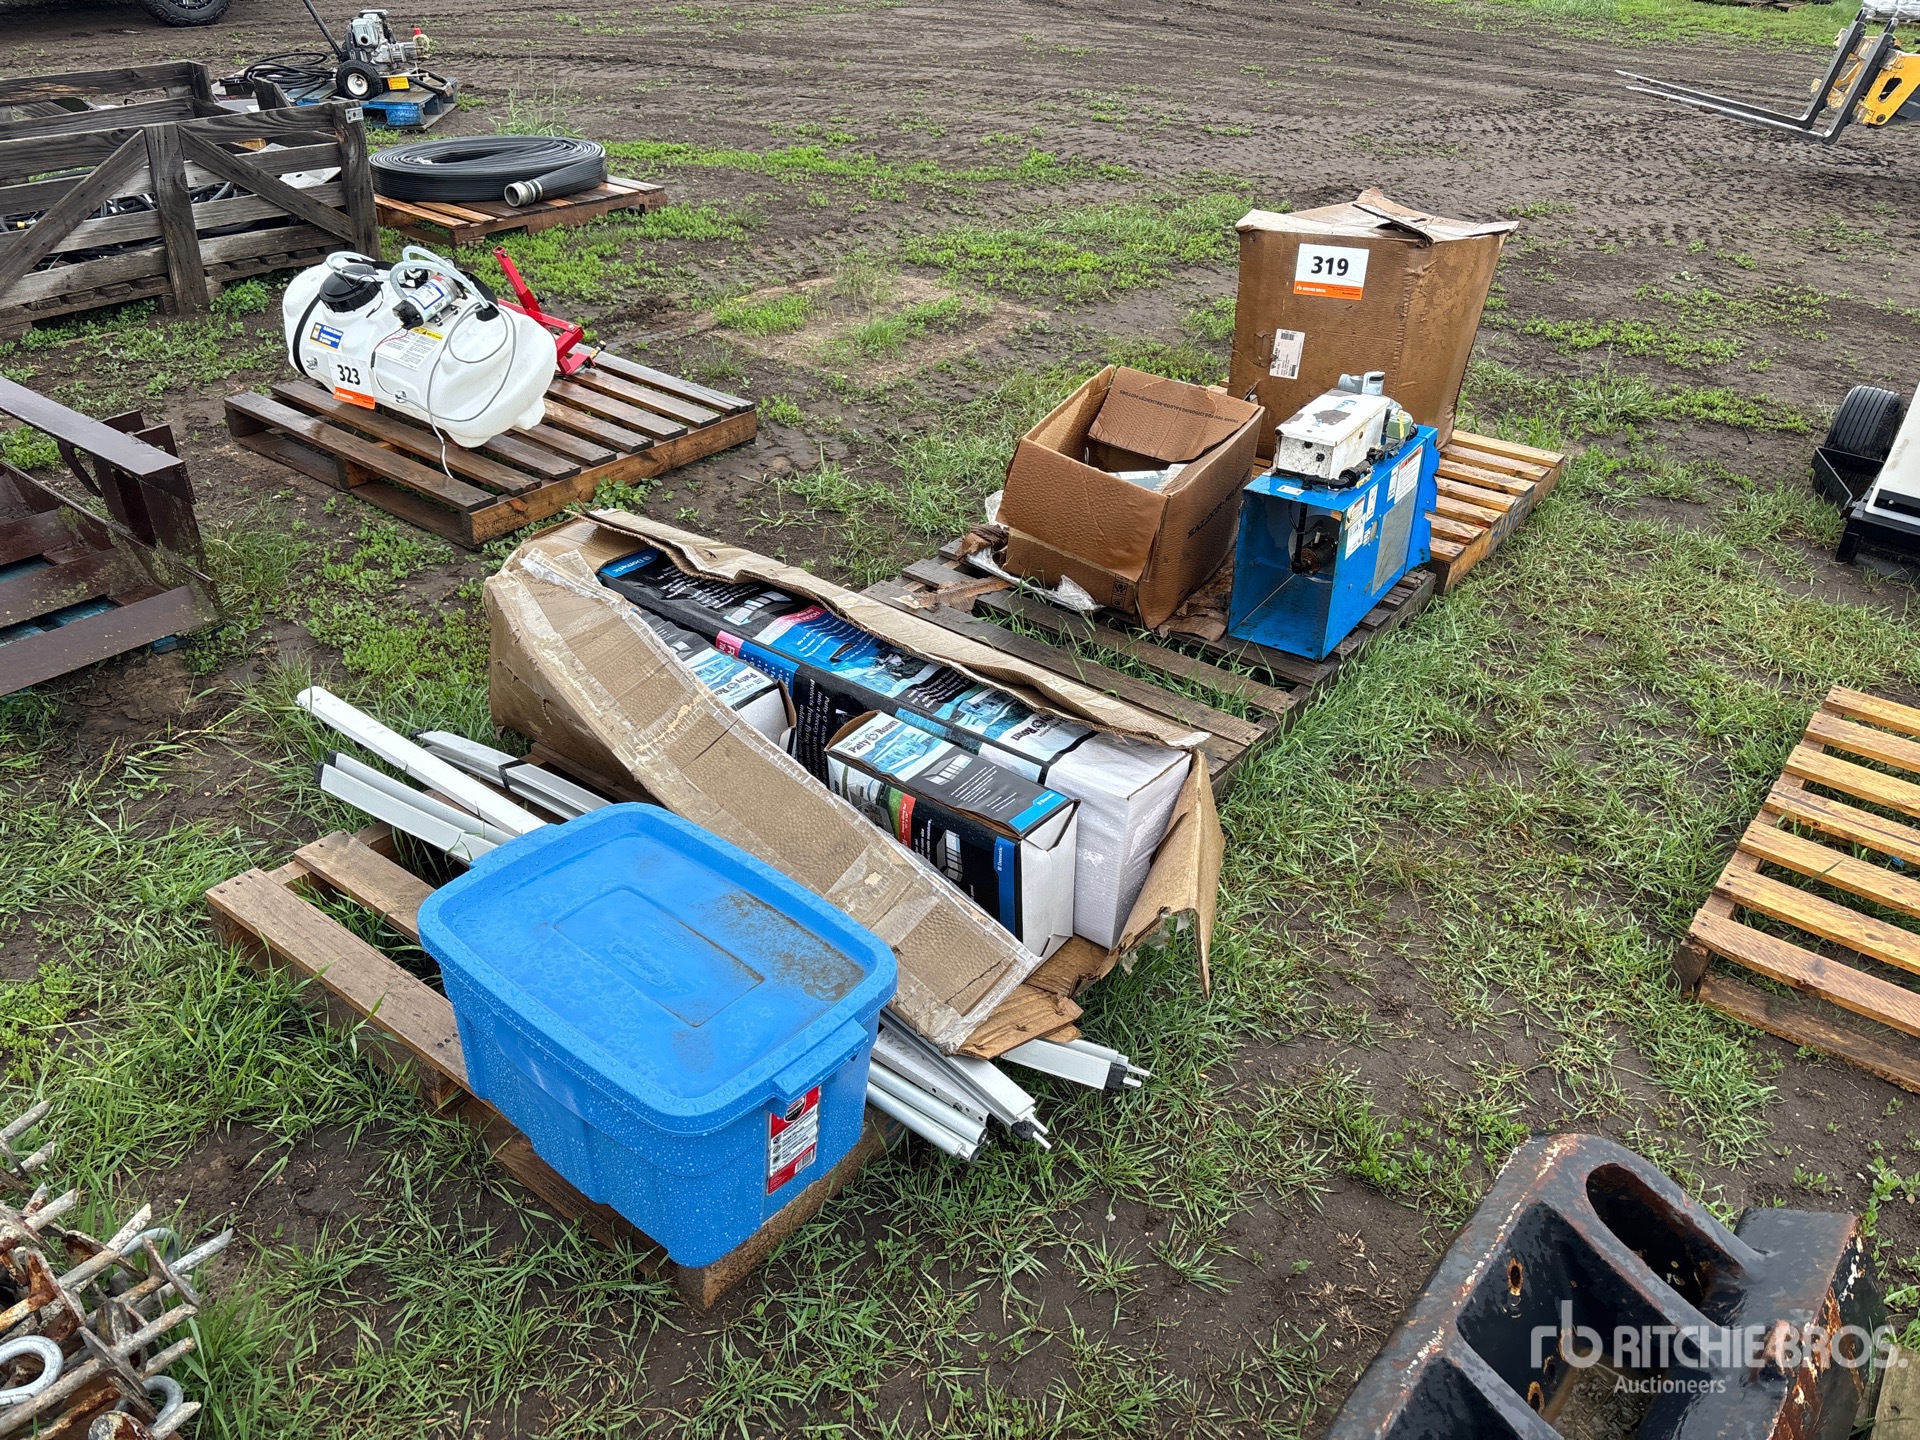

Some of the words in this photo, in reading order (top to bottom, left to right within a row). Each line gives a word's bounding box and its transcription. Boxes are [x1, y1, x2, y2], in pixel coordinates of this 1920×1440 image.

[1311, 256, 1349, 276] 319
[337, 364, 361, 385] 323
[738, 673, 758, 685] Patty
[822, 695, 830, 715] Patty
[847, 738, 872, 753] Patty
[876, 720, 900, 735] Room
